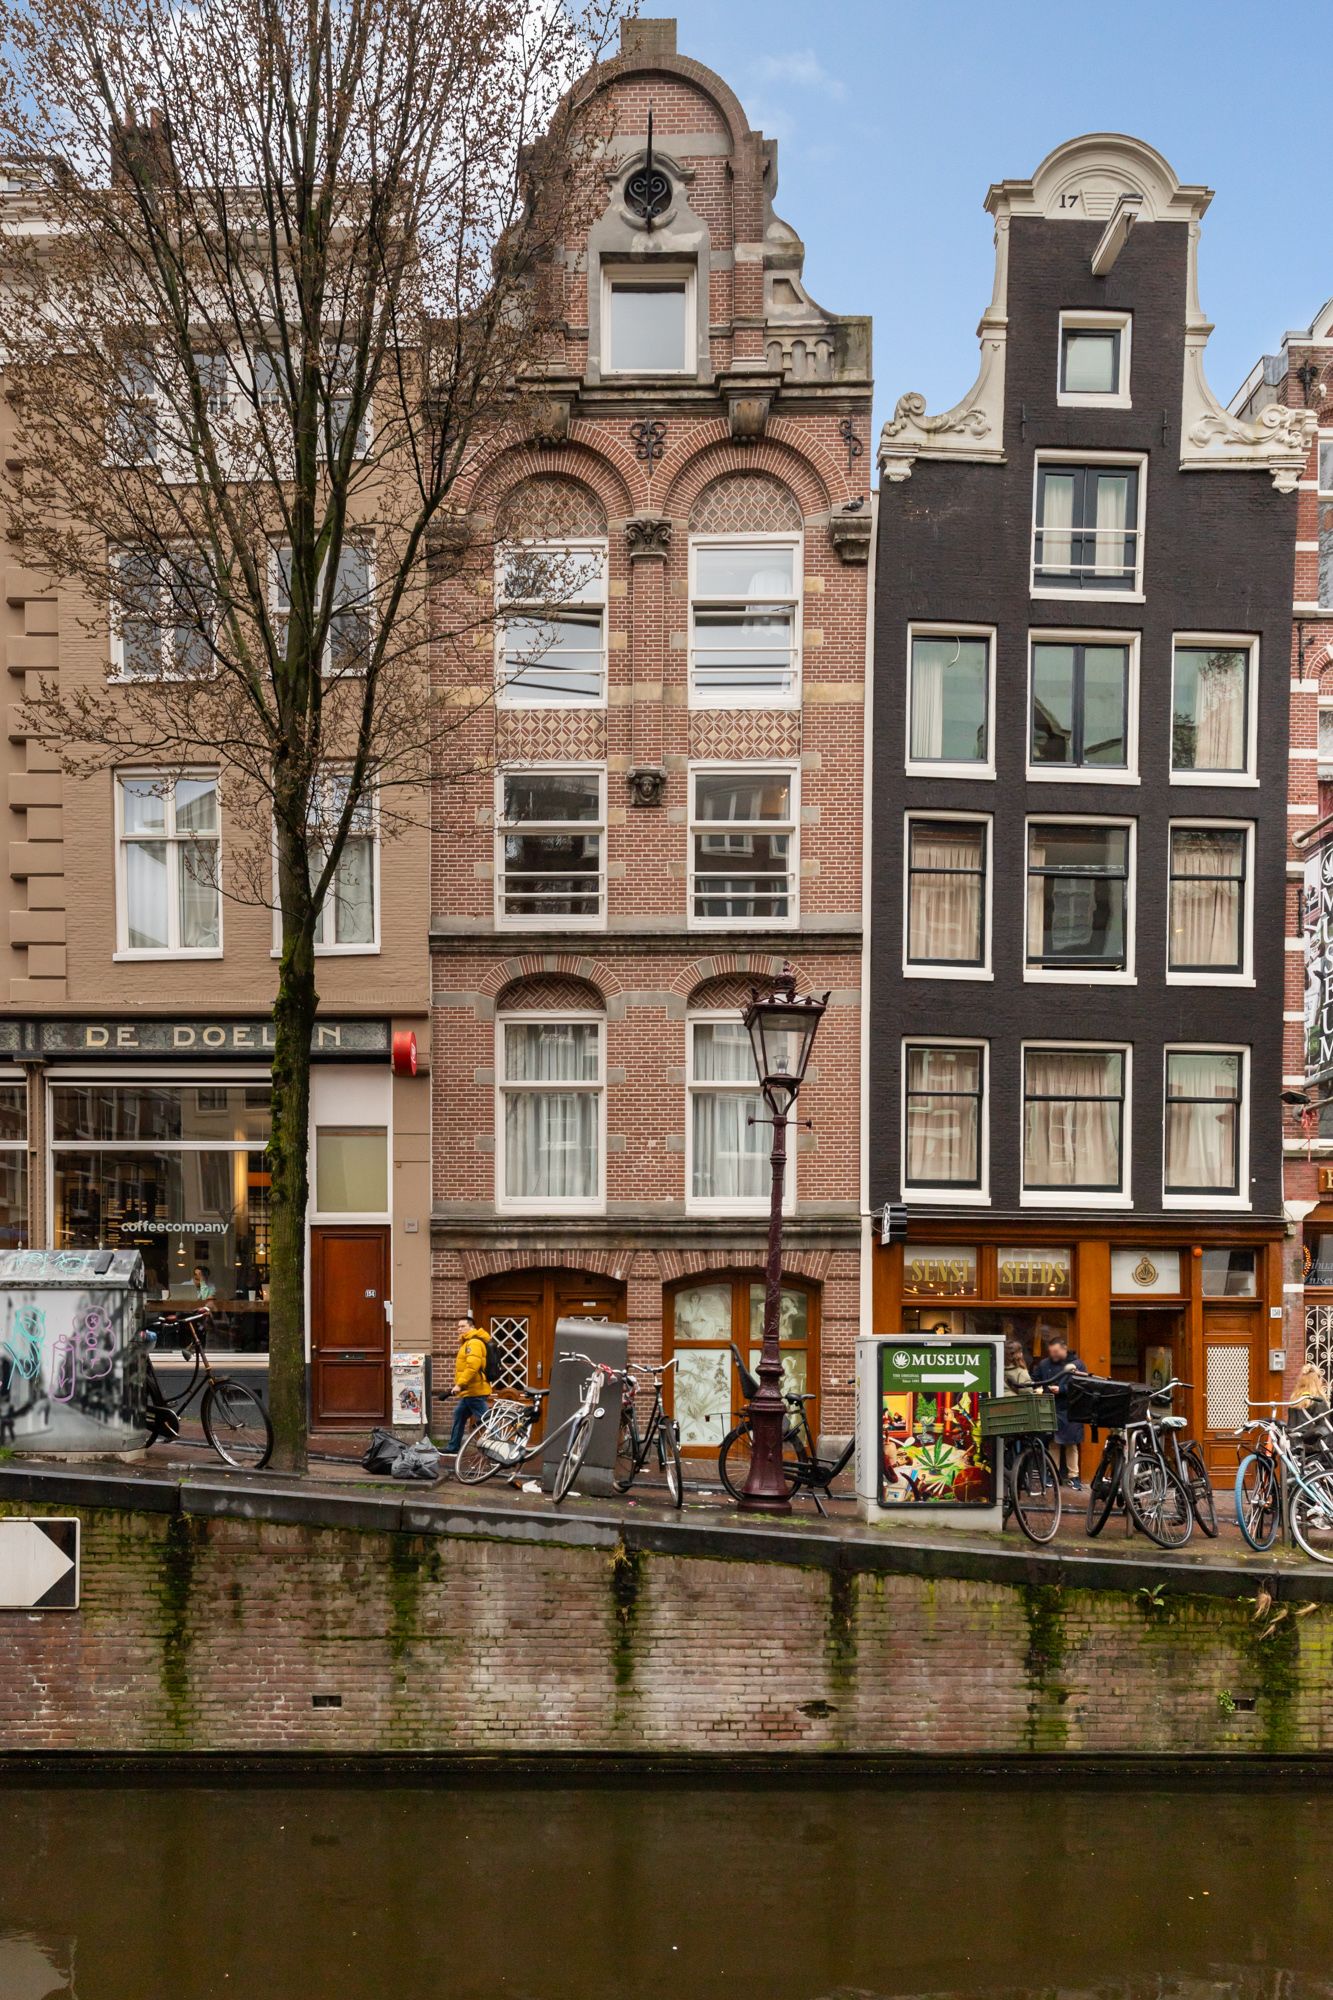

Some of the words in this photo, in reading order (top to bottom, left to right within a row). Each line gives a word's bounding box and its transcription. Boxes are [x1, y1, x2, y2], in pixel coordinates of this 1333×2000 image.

[1059, 194, 1079, 208] 17
[86, 1027, 138, 1046] DE
[174, 1027, 341, 1046] DOELN
[121, 1220, 229, 1234] coffeecompany
[911, 1259, 969, 1282] SENSI
[1002, 1261, 1066, 1284] SEEDS
[912, 1354, 980, 1366] MUSEUM
